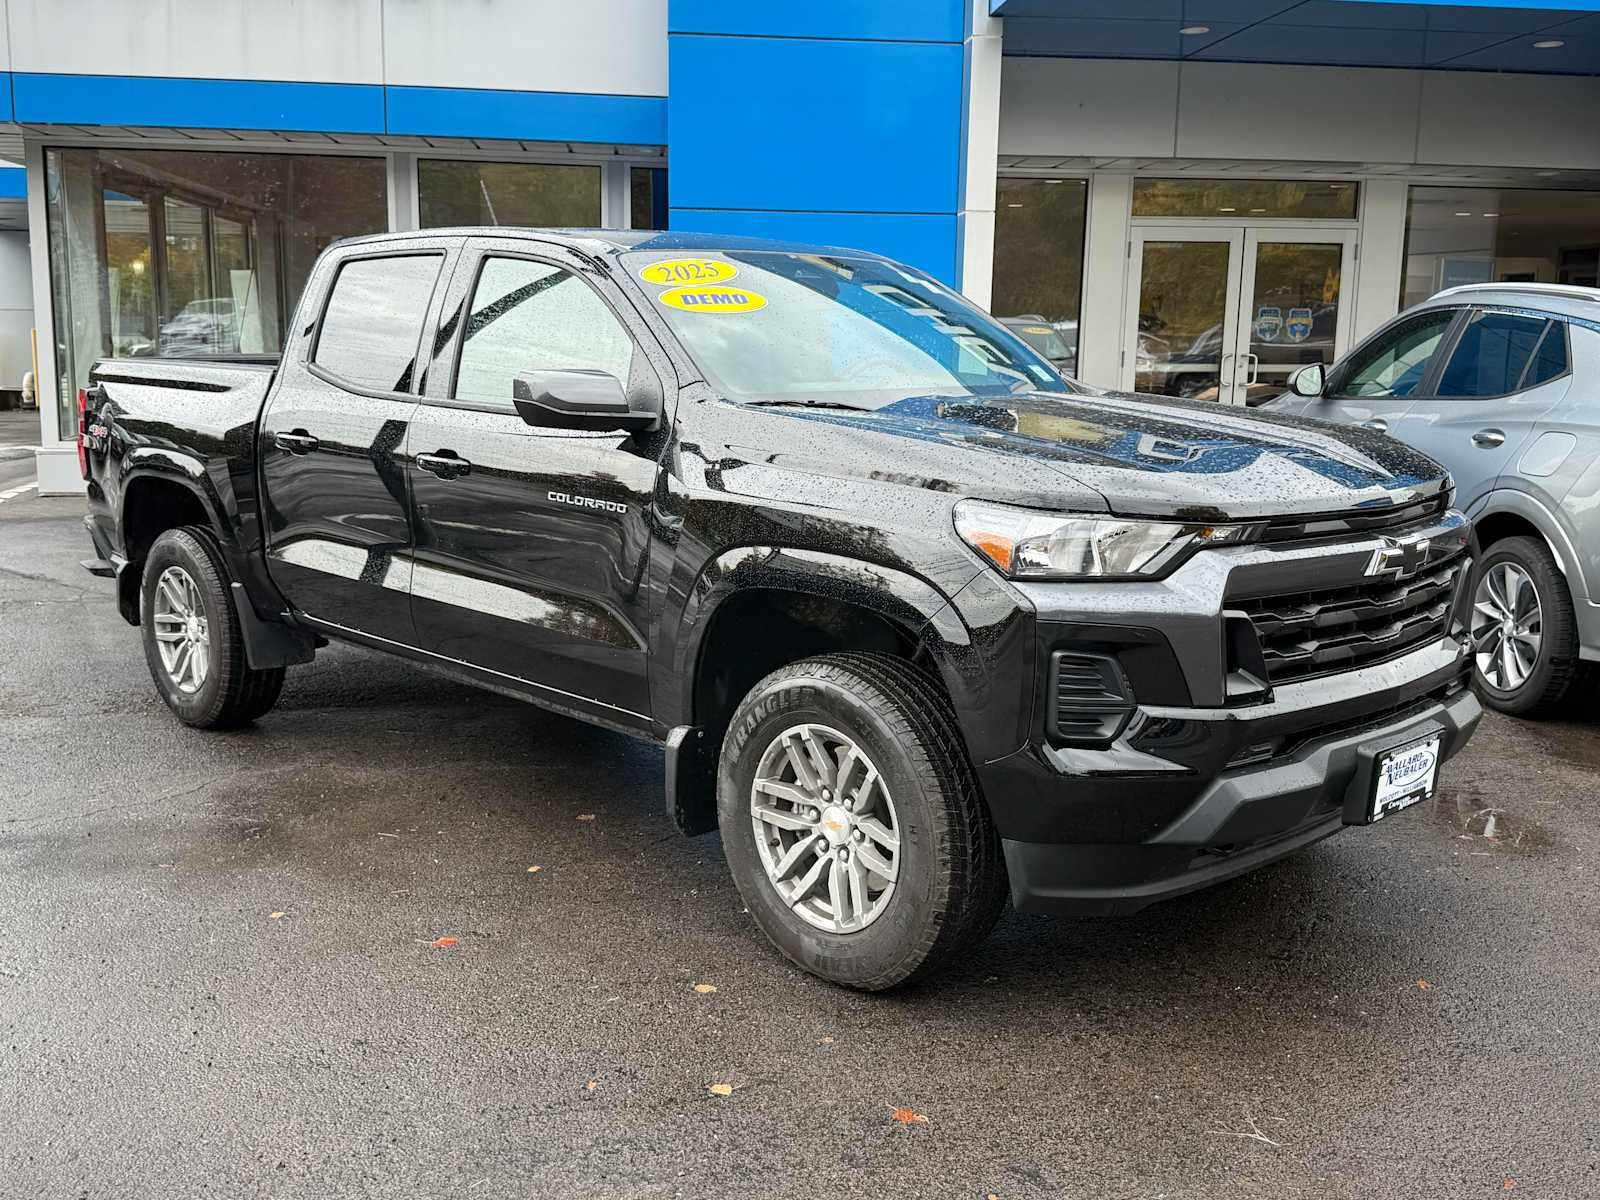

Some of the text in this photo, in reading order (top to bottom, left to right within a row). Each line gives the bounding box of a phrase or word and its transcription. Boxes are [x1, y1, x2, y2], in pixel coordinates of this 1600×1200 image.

[657, 262, 719, 282] 2025
[681, 294, 748, 305] DEMO
[547, 491, 628, 514] COLORADO
[725, 686, 816, 766] WRANGLER
